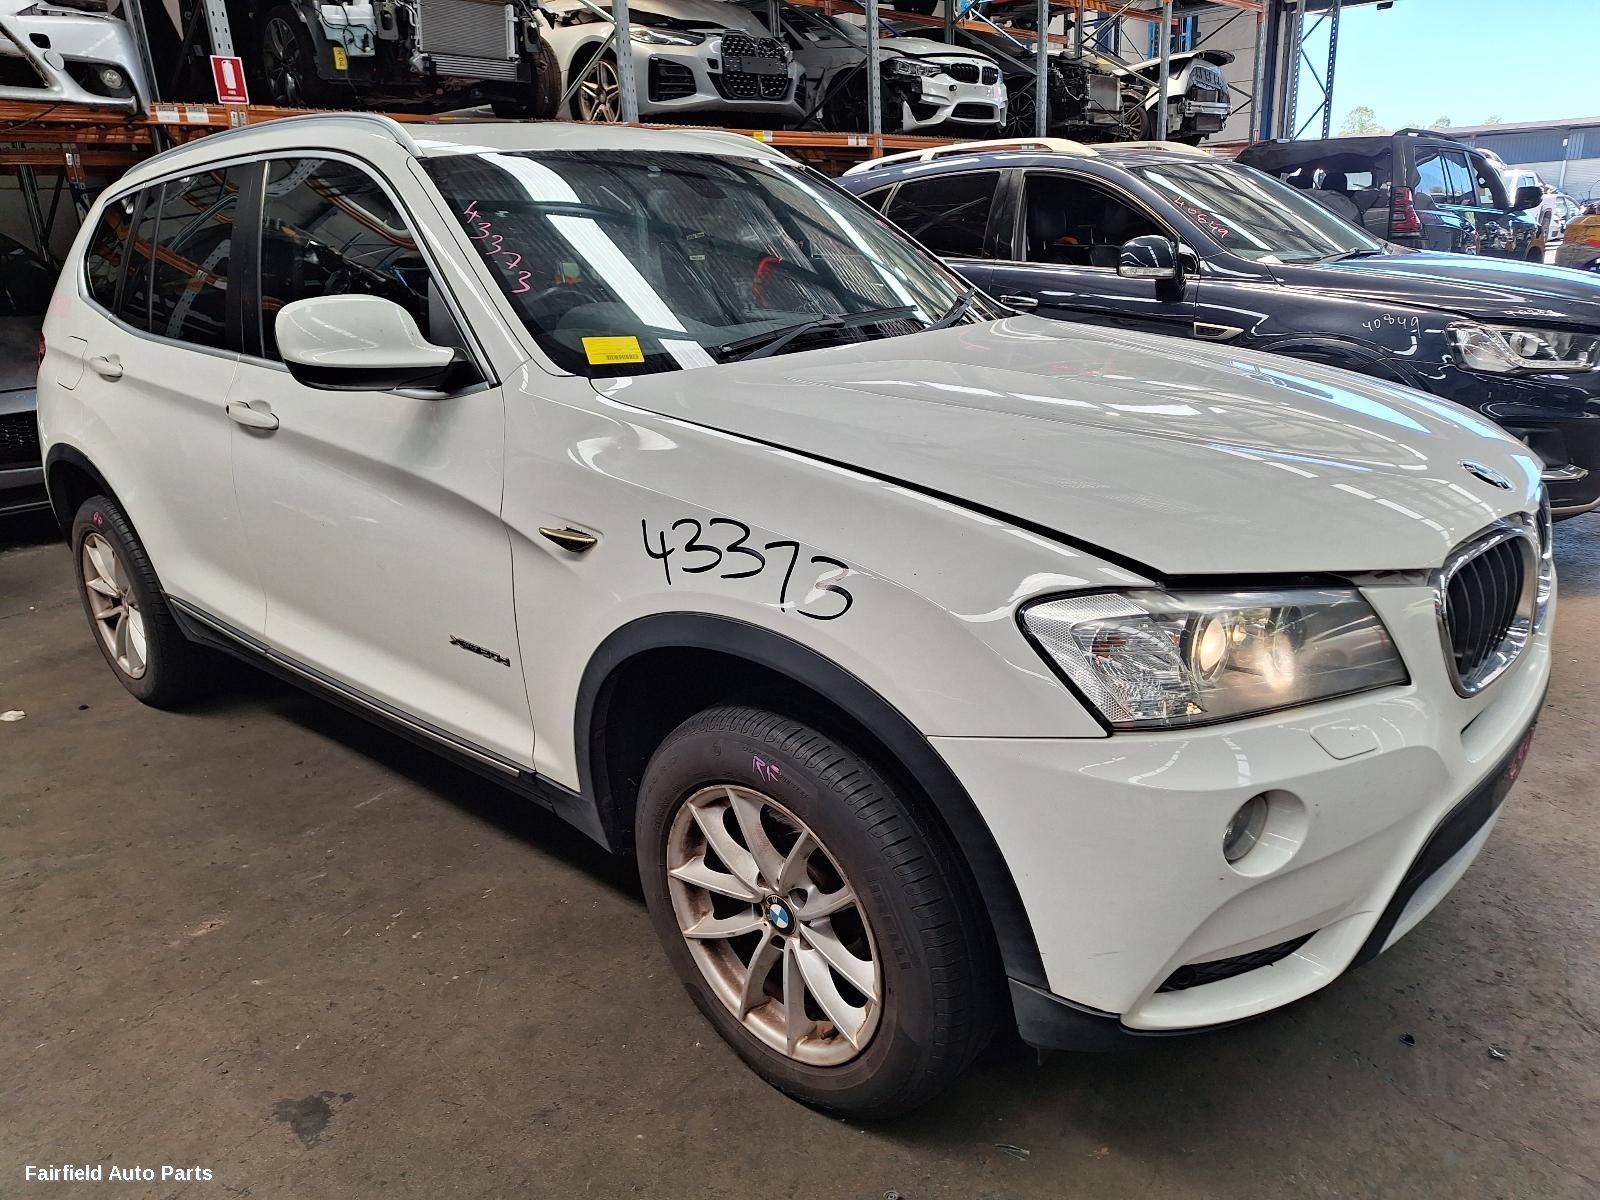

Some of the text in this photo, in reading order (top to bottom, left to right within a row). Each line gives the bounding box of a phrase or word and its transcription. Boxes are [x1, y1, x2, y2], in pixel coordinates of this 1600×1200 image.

[463, 200, 532, 294] 43373
[1361, 313, 1422, 339] 40849
[641, 517, 853, 621] 43373
